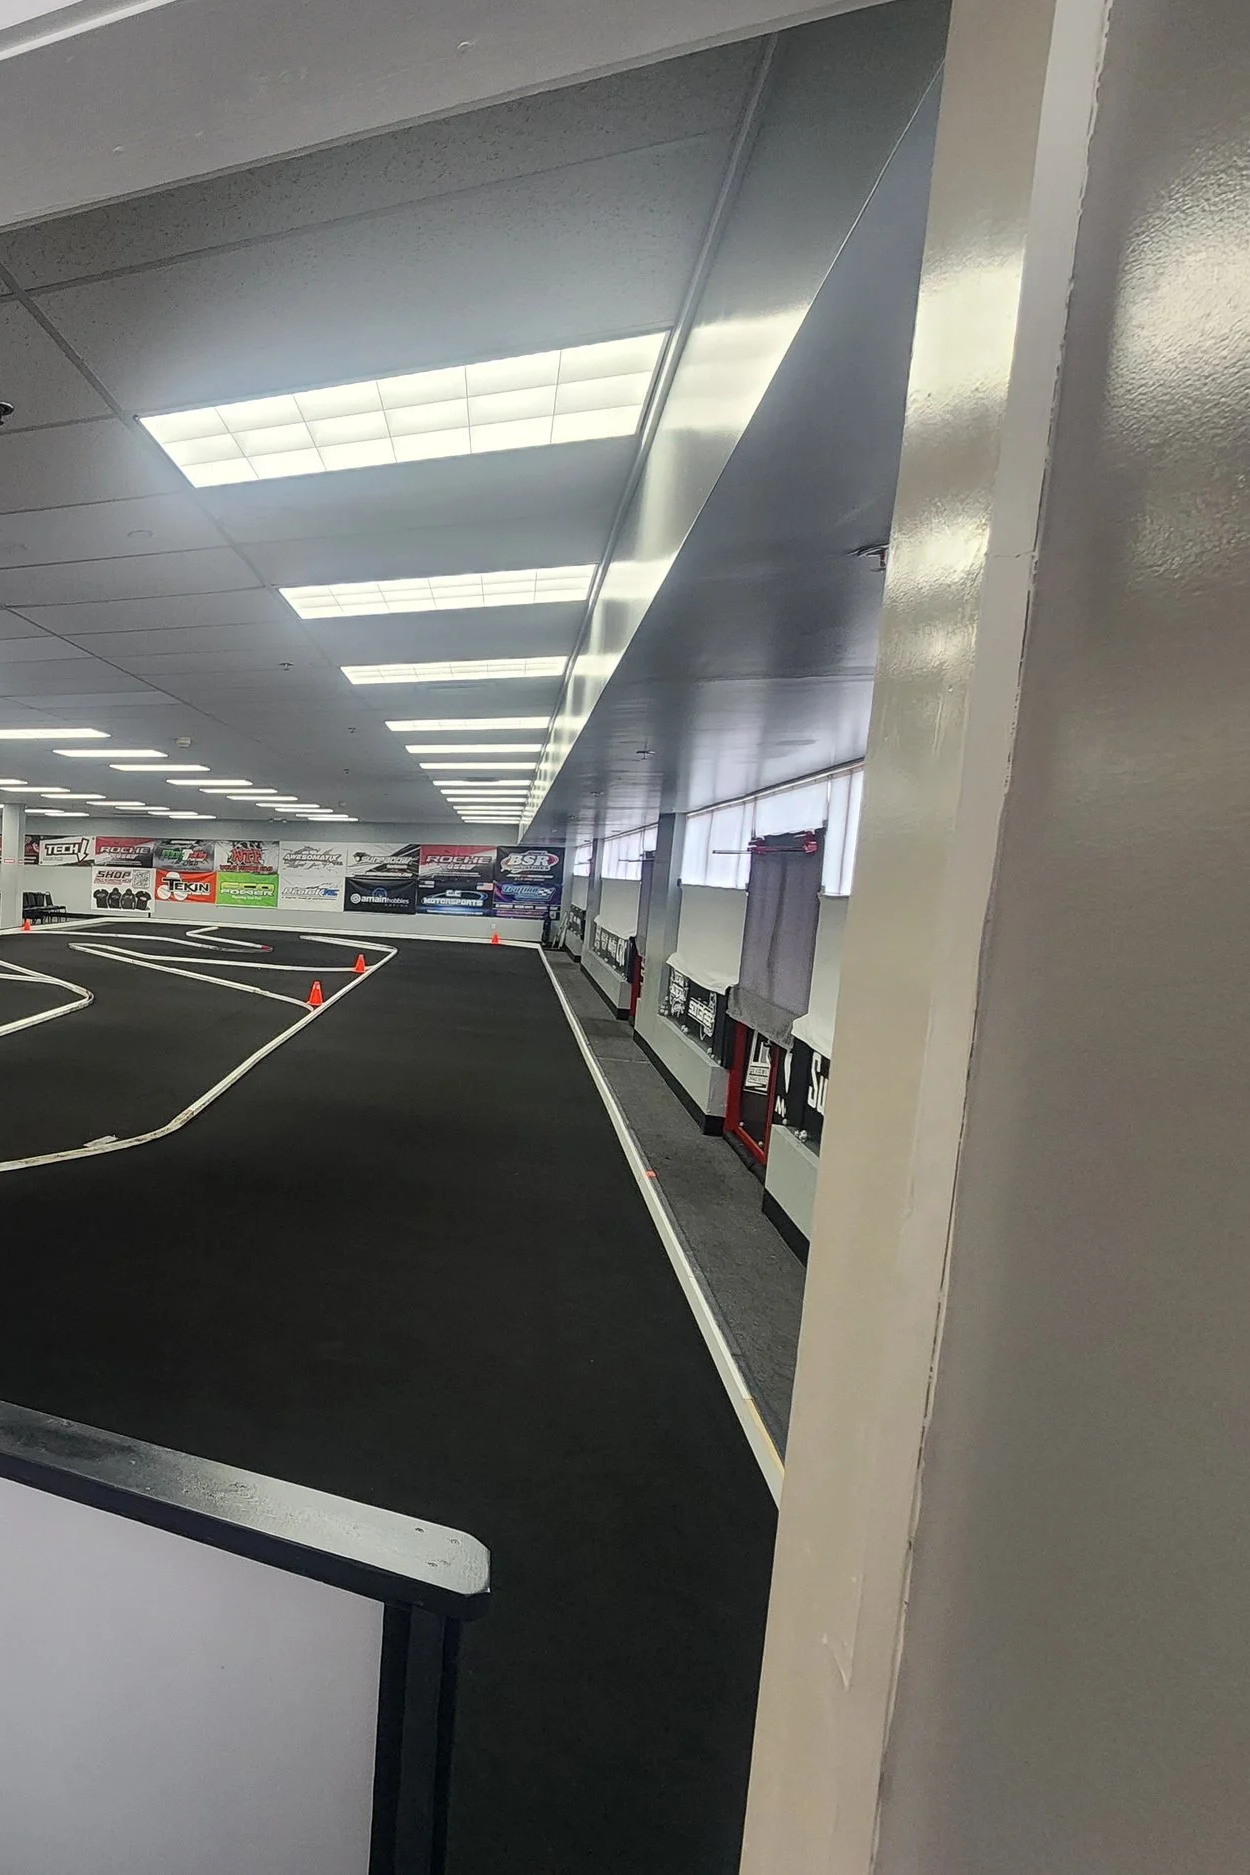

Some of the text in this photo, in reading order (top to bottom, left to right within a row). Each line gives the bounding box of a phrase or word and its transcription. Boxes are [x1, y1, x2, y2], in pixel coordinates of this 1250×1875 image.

[45, 844, 79, 855] TECH
[100, 846, 150, 854] ROCHE
[426, 855, 490, 864] ROCHE
[508, 855, 549, 866] BSR
[97, 870, 132, 879] SHOP
[162, 879, 209, 892] TEKIN
[423, 897, 484, 907] MOTORSPORTS
